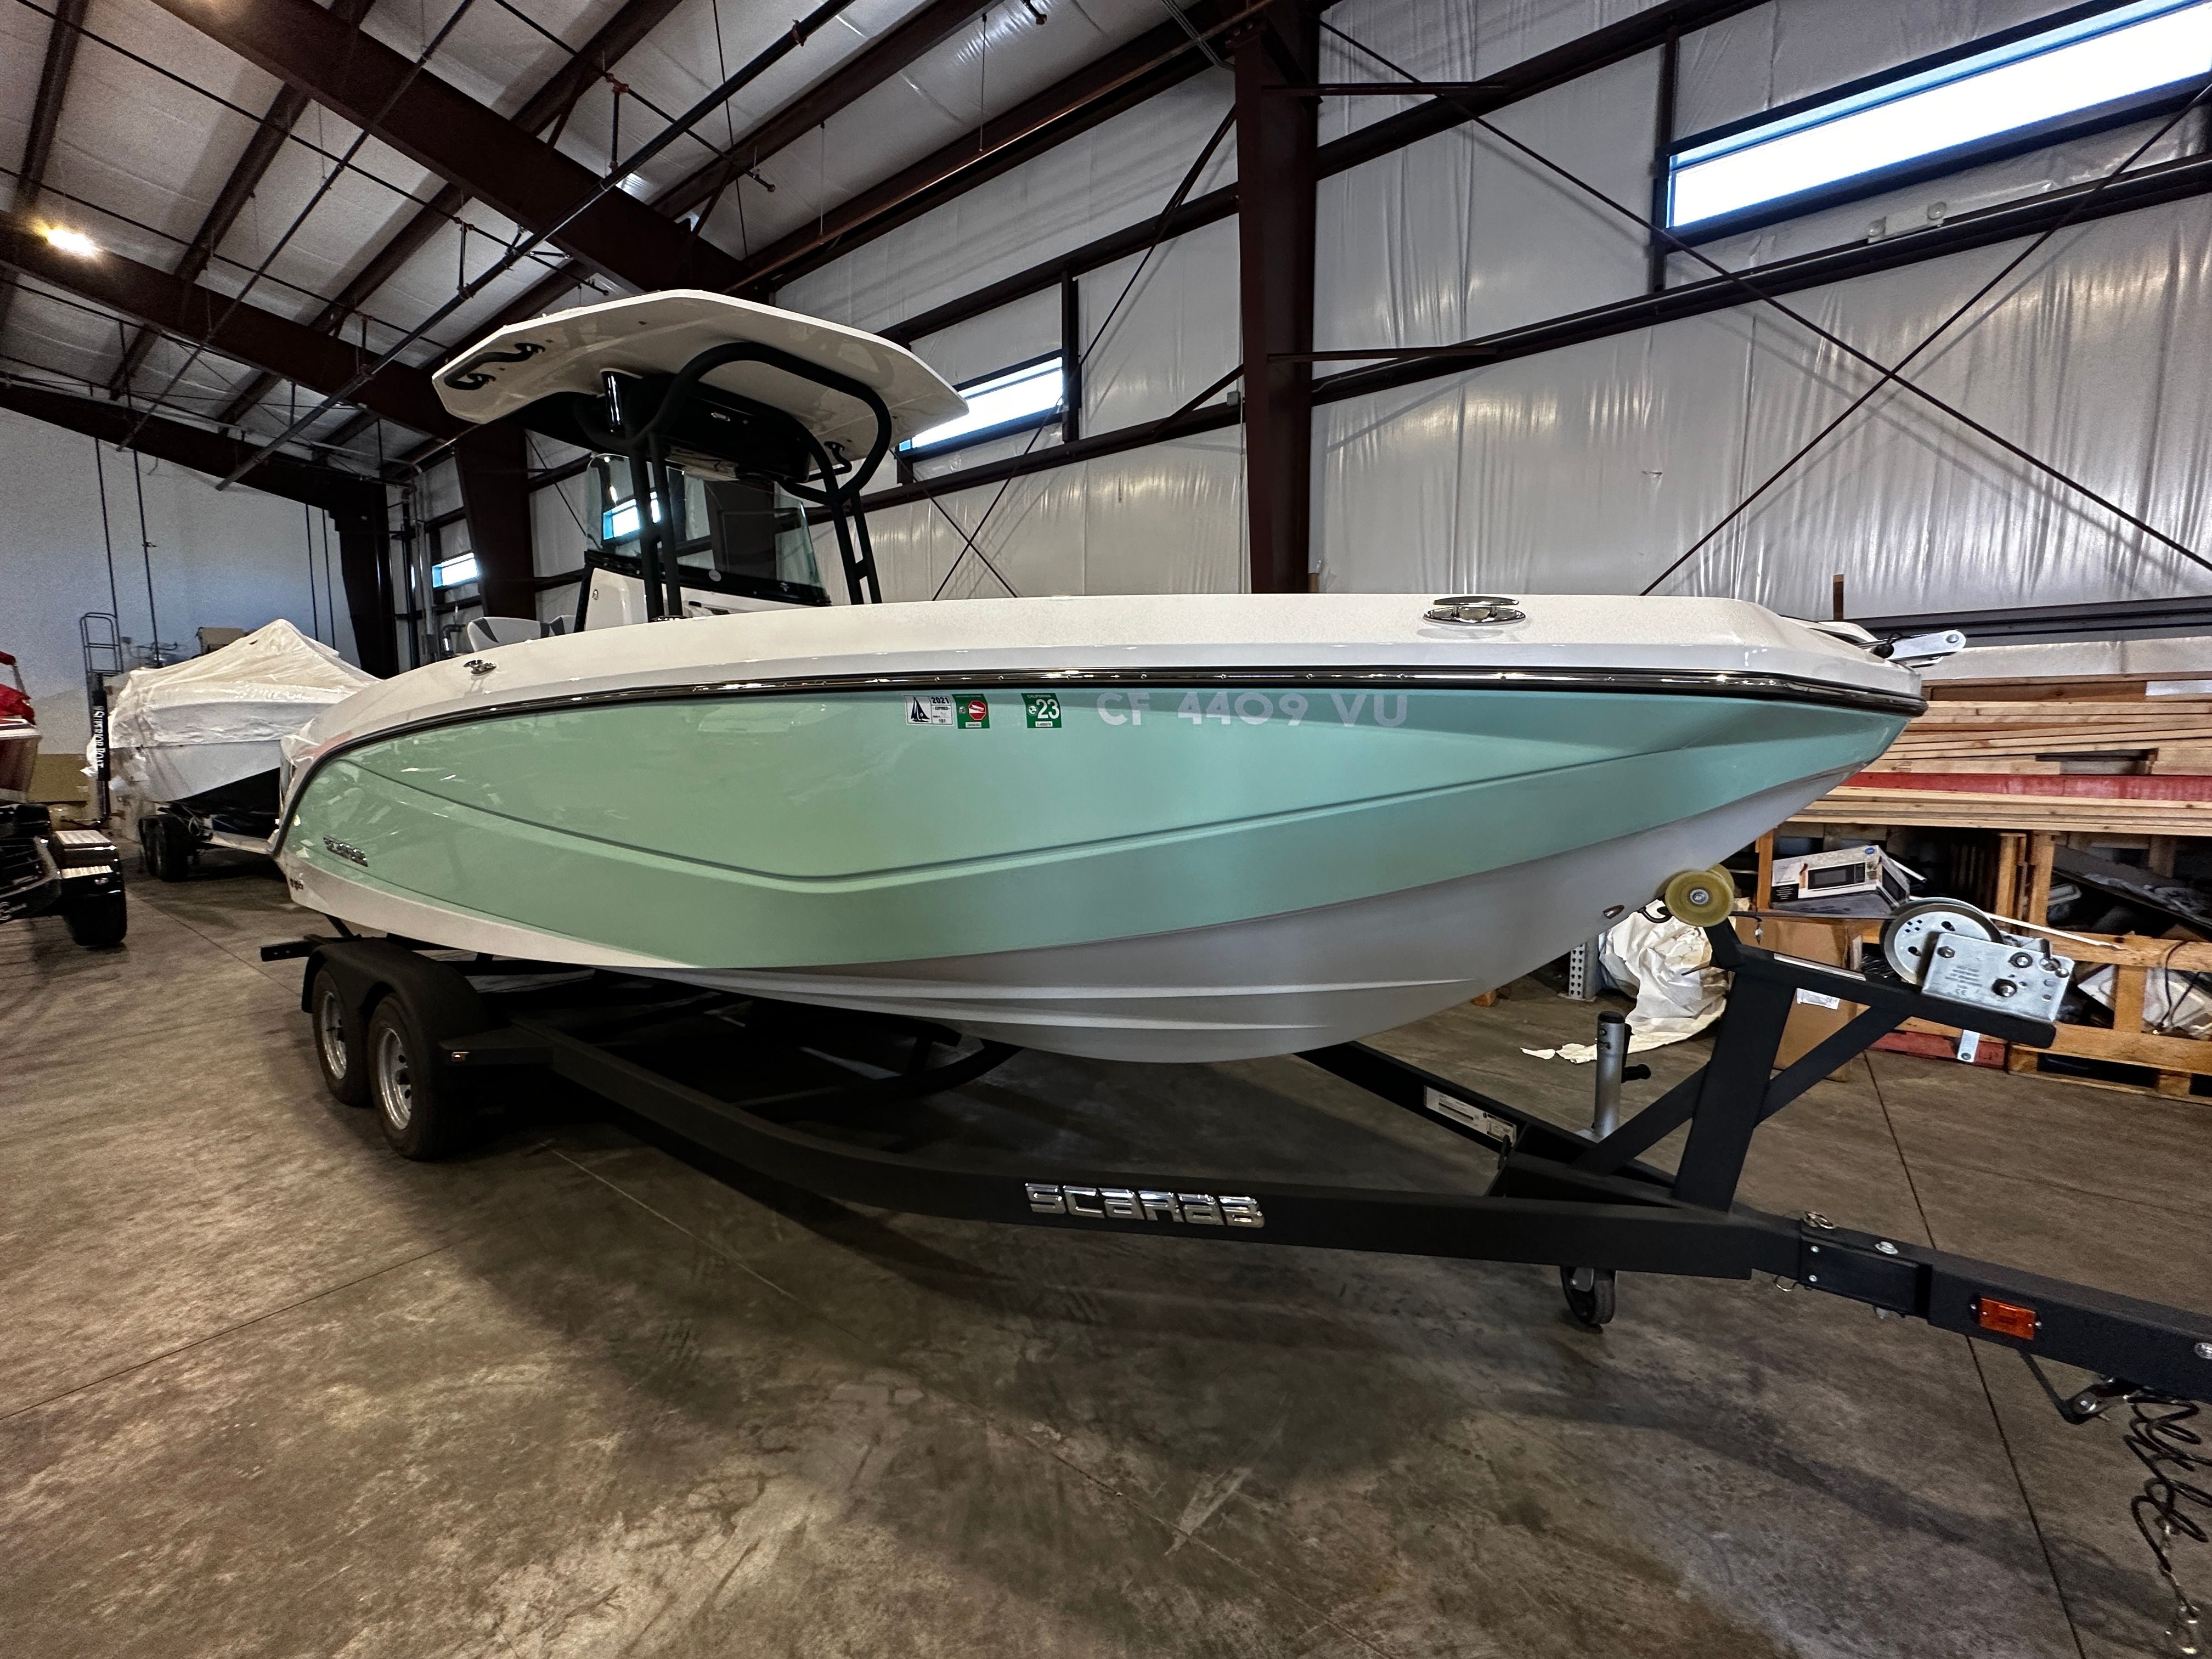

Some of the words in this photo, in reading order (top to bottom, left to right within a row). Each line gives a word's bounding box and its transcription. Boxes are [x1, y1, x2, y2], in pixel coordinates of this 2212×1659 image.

[1036, 698, 1060, 719] 23
[1097, 692, 1150, 726] CF
[1177, 692, 1309, 726] 4409
[1330, 693, 1408, 727] VU
